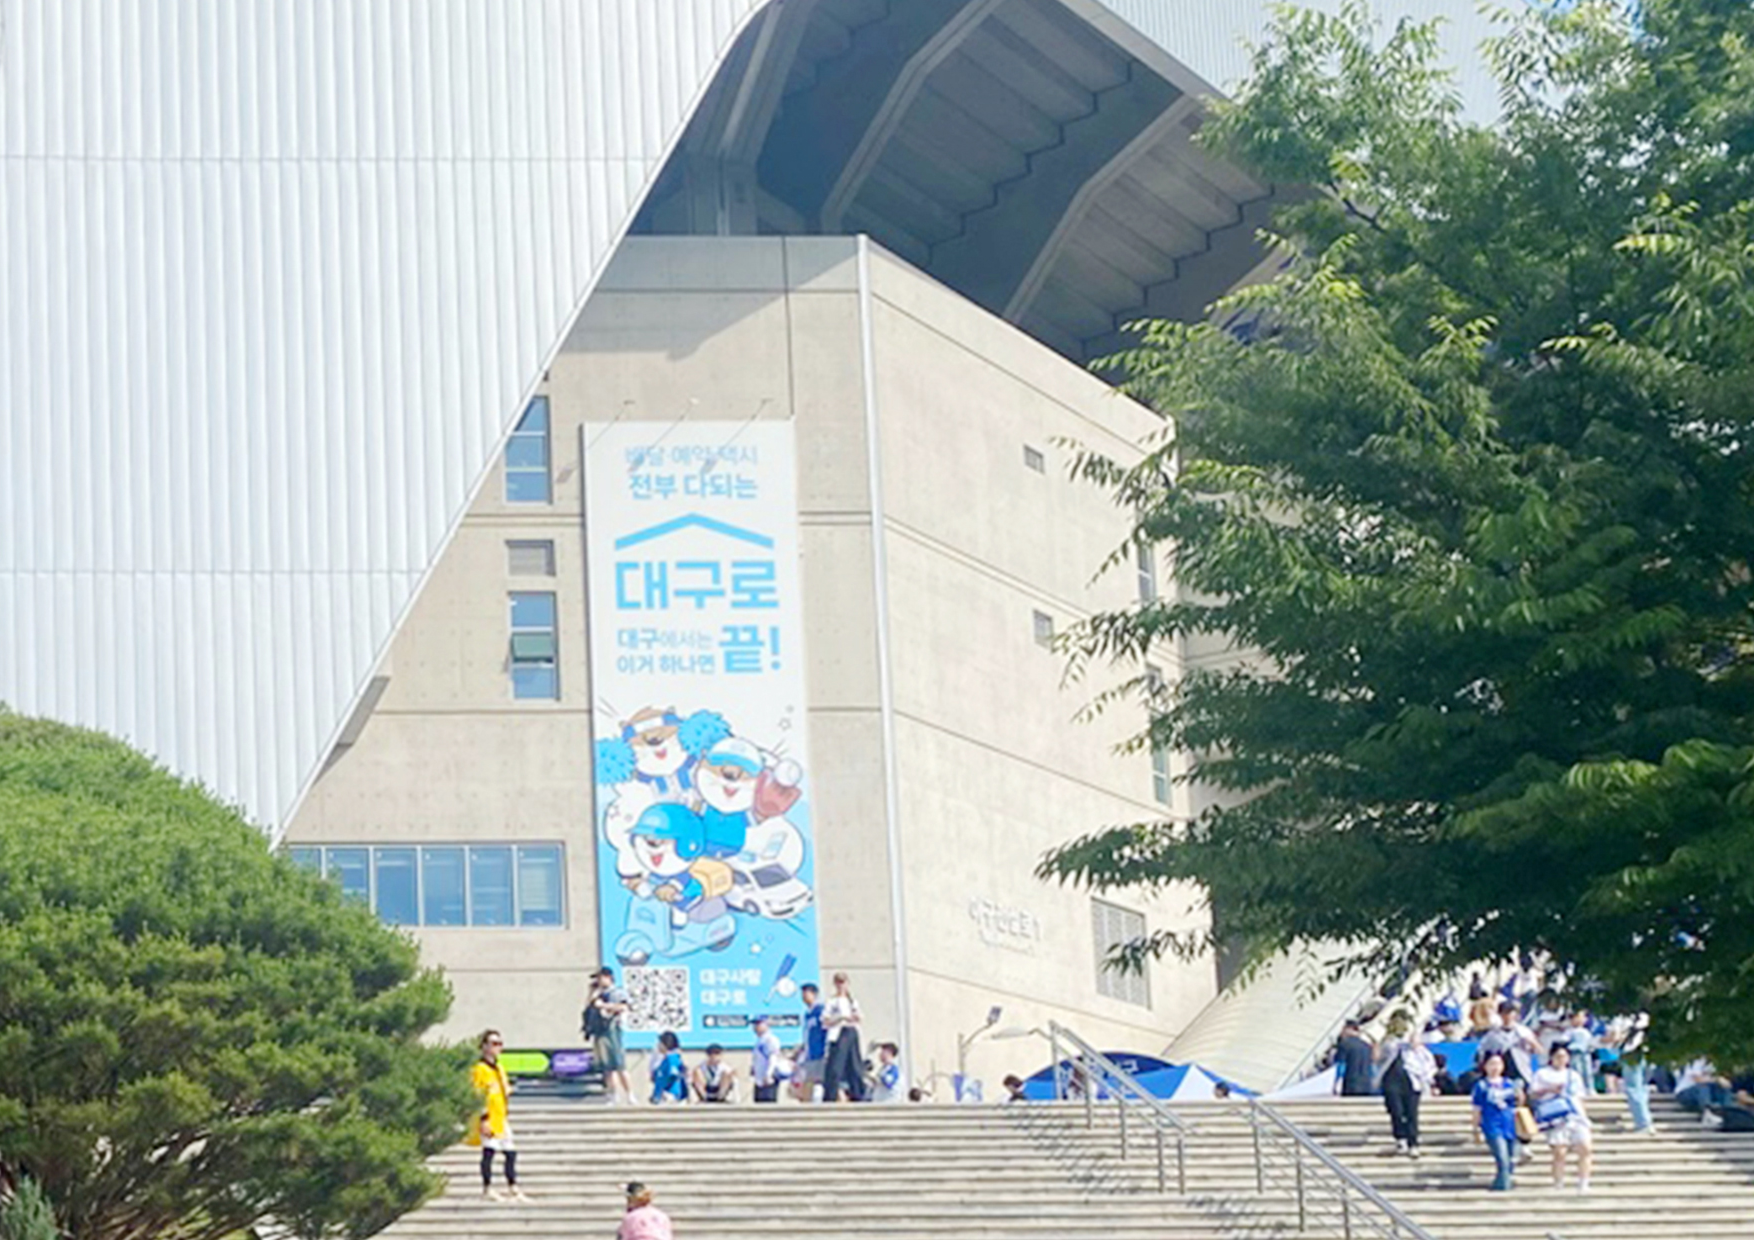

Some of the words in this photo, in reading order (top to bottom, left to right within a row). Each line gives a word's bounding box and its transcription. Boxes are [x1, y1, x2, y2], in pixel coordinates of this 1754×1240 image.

[629, 474, 677, 500] 전부
[615, 560, 780, 610] 대구로
[617, 627, 713, 649] 대구에서는
[718, 624, 781, 674] 끝!
[617, 654, 654, 675] 이거
[659, 654, 716, 675] 하나면
